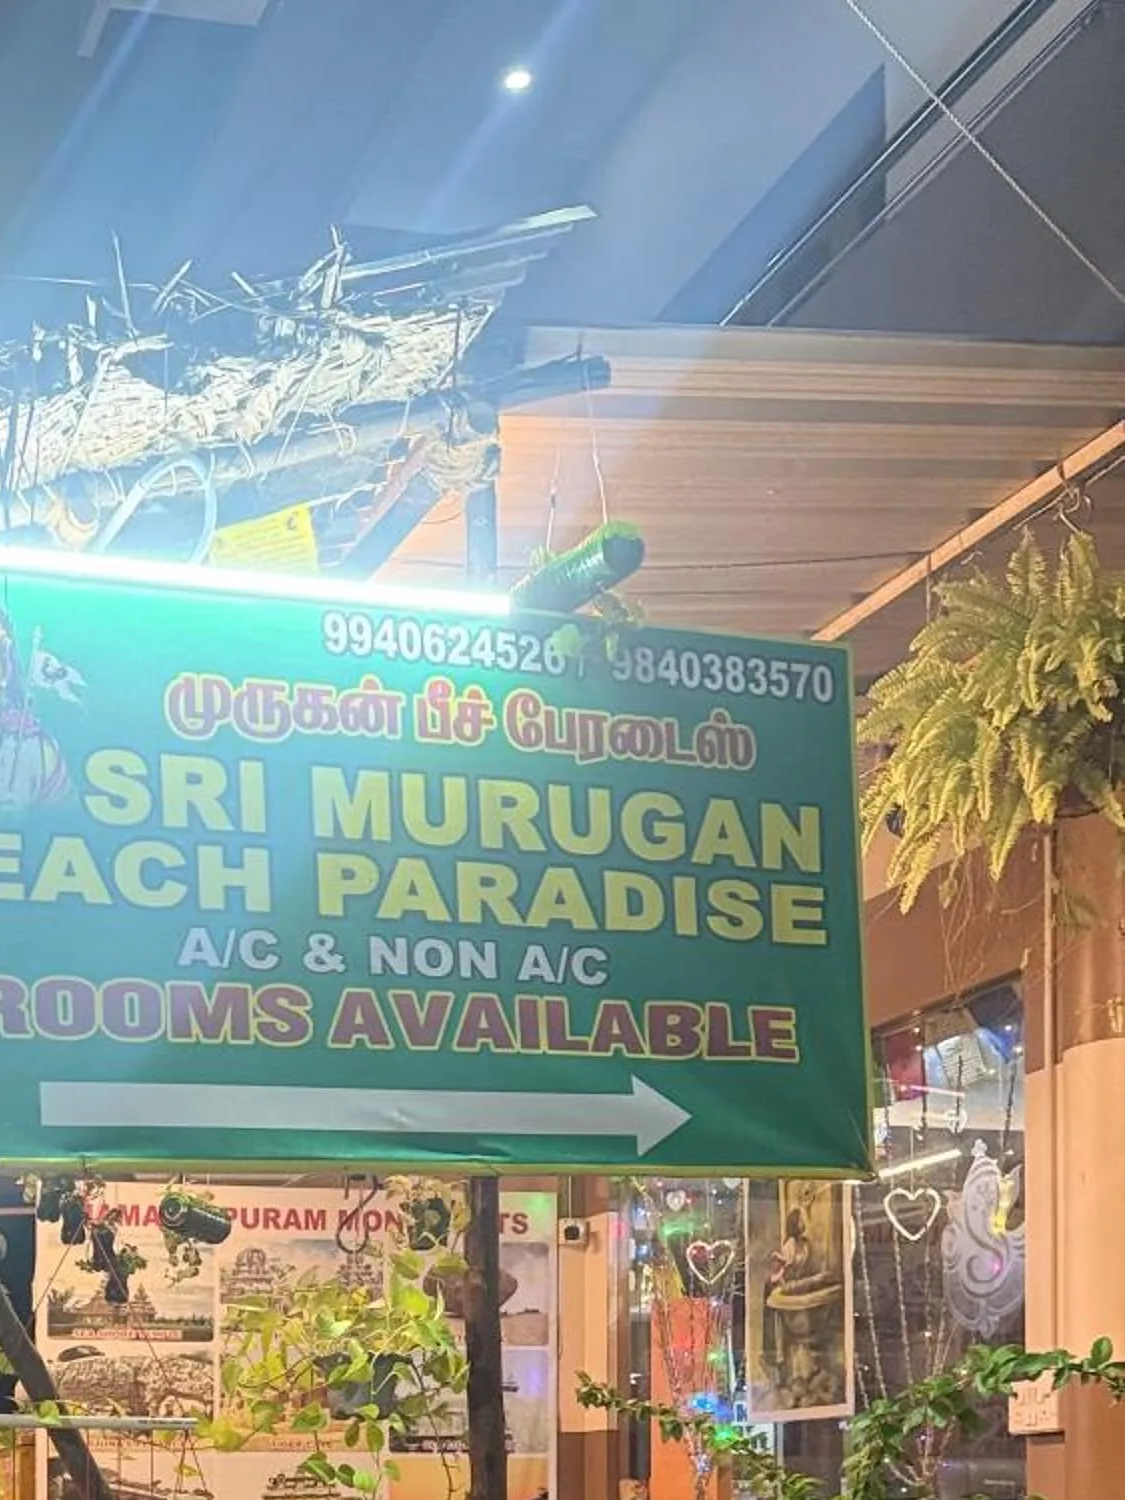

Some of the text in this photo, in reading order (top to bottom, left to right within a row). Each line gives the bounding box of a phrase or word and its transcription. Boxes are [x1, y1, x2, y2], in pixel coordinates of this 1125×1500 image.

[612, 643, 834, 702] 9840383570
[166, 672, 757, 771] முருகன் பீச் பேரடைஸ்
[83, 748, 823, 874] SRI MURUGAN
[316, 852, 829, 946] PARADISE
[178, 927, 610, 986] A/C & NON A/C
[326, 987, 802, 1065] AVAILABLE
[338, 1208, 529, 1235] MONTS
